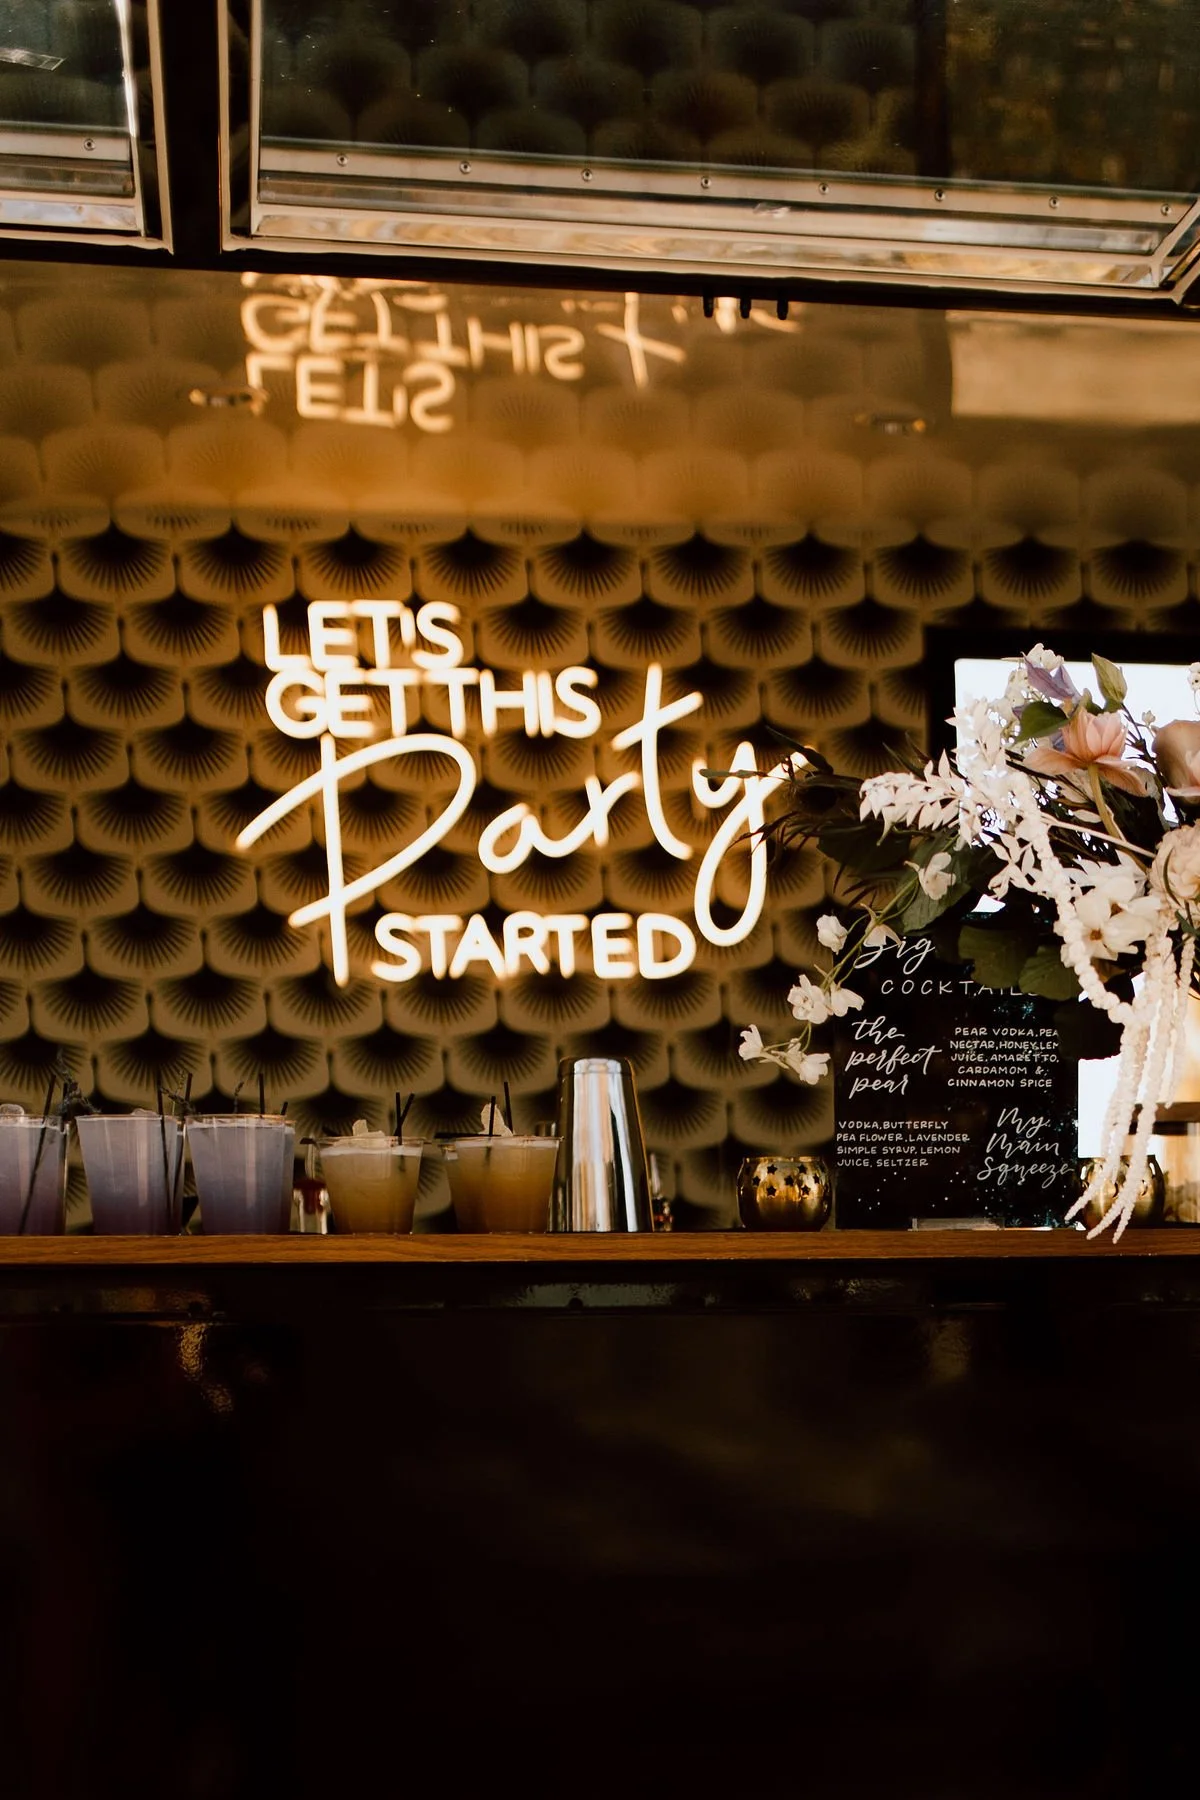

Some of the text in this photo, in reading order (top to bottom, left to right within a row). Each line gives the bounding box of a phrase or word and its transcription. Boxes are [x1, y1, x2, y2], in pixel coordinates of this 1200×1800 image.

[262, 600, 464, 672] LET'S
[264, 665, 602, 739] GET THIS
[235, 663, 815, 987] Party
[371, 910, 698, 983] STARTED
[880, 979, 1039, 997] COCKTAIL
[851, 1015, 906, 1045] the
[954, 1026, 989, 1036] PEAR
[1039, 1028, 1060, 1037] PEA
[844, 1045, 943, 1076] perfect
[957, 1065, 1028, 1075] CARDAMOM
[848, 1073, 910, 1100] pear
[947, 1078, 1053, 1088] CINNAMON SPICE
[882, 1120, 949, 1130] BUTTERFLY
[996, 1107, 1051, 1139] My
[836, 1132, 857, 1142] PEA
[908, 1133, 971, 1142] LAVENDER
[836, 1145, 878, 1155] SIMPLE
[920, 1145, 961, 1154] LEMON
[985, 1132, 1060, 1159] Main
[876, 1158, 929, 1167] SELTZER
[976, 1156, 1076, 1189] Squeeze
